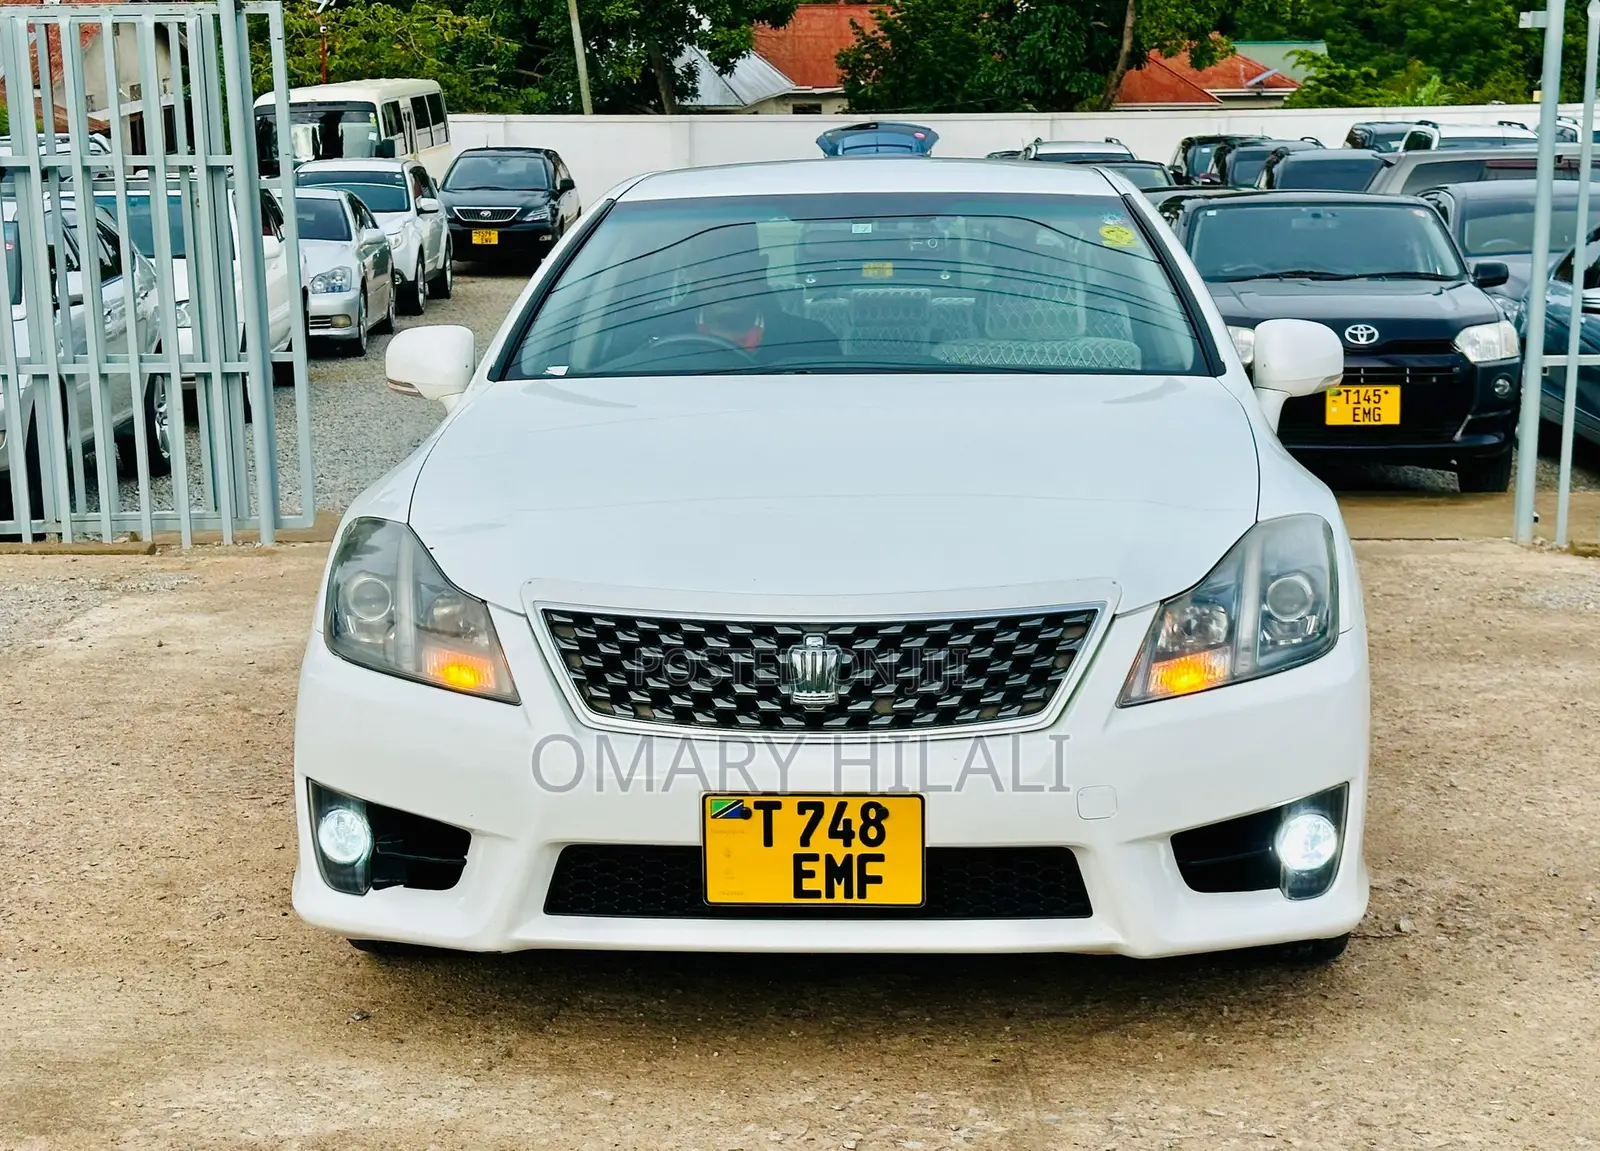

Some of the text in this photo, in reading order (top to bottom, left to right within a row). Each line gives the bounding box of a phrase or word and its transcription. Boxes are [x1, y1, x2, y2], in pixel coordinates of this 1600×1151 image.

[1343, 389, 1382, 405] T145
[1352, 407, 1382, 423] EMG
[753, 800, 886, 847] T 748
[793, 853, 885, 899] EMF
